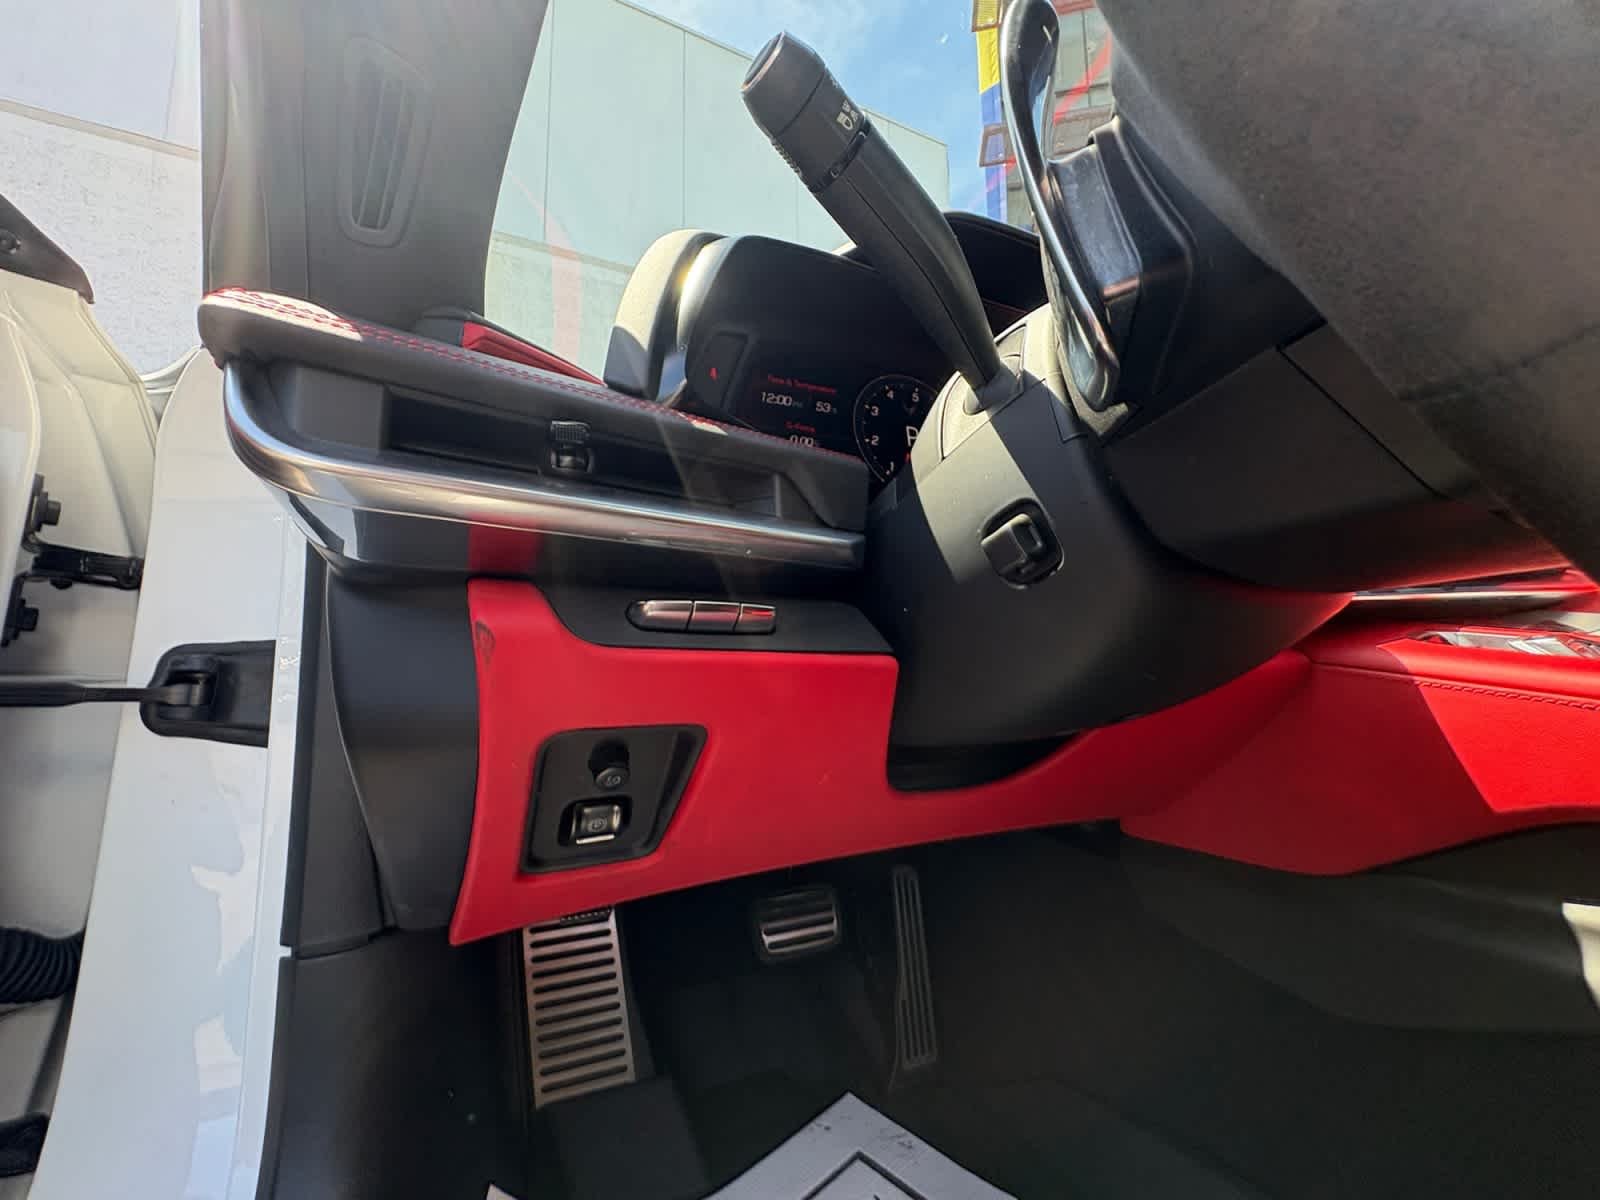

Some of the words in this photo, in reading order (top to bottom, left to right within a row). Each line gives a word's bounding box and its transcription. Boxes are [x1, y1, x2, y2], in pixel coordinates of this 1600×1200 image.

[760, 391, 793, 407] 12:00
[886, 390, 894, 399] 4
[911, 393, 920, 403] 5
[815, 400, 832, 413] 53
[871, 406, 879, 416] 3
[790, 434, 814, 448] 000
[871, 434, 879, 446] 2
